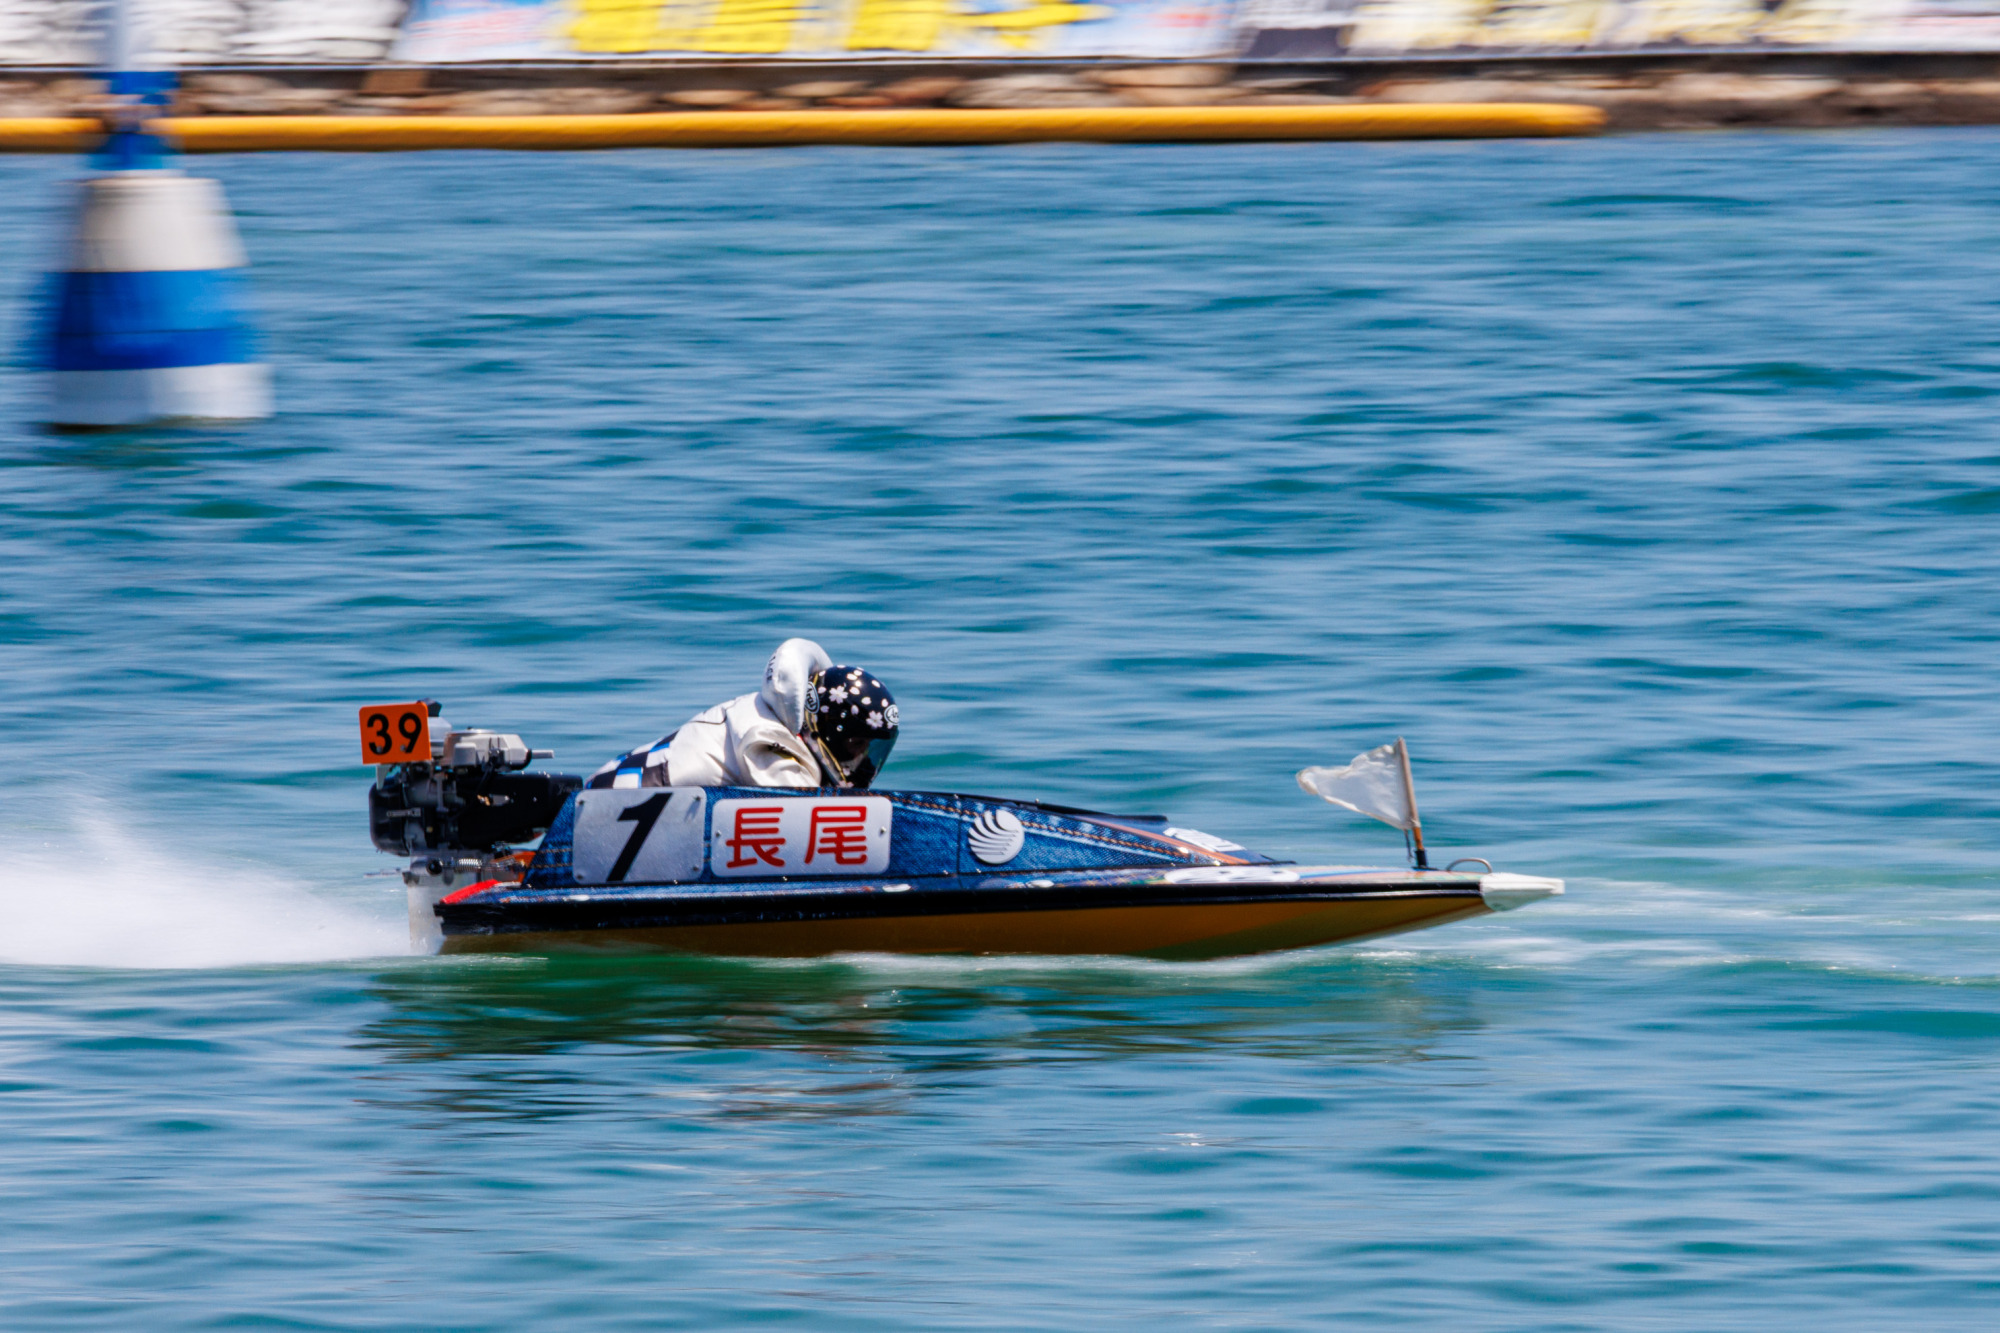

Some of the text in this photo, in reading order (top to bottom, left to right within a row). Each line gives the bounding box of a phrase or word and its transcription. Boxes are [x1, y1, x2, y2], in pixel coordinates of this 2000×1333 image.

[367, 712, 422, 755] 39
[606, 792, 673, 881] 1
[725, 805, 868, 868] 長尾
